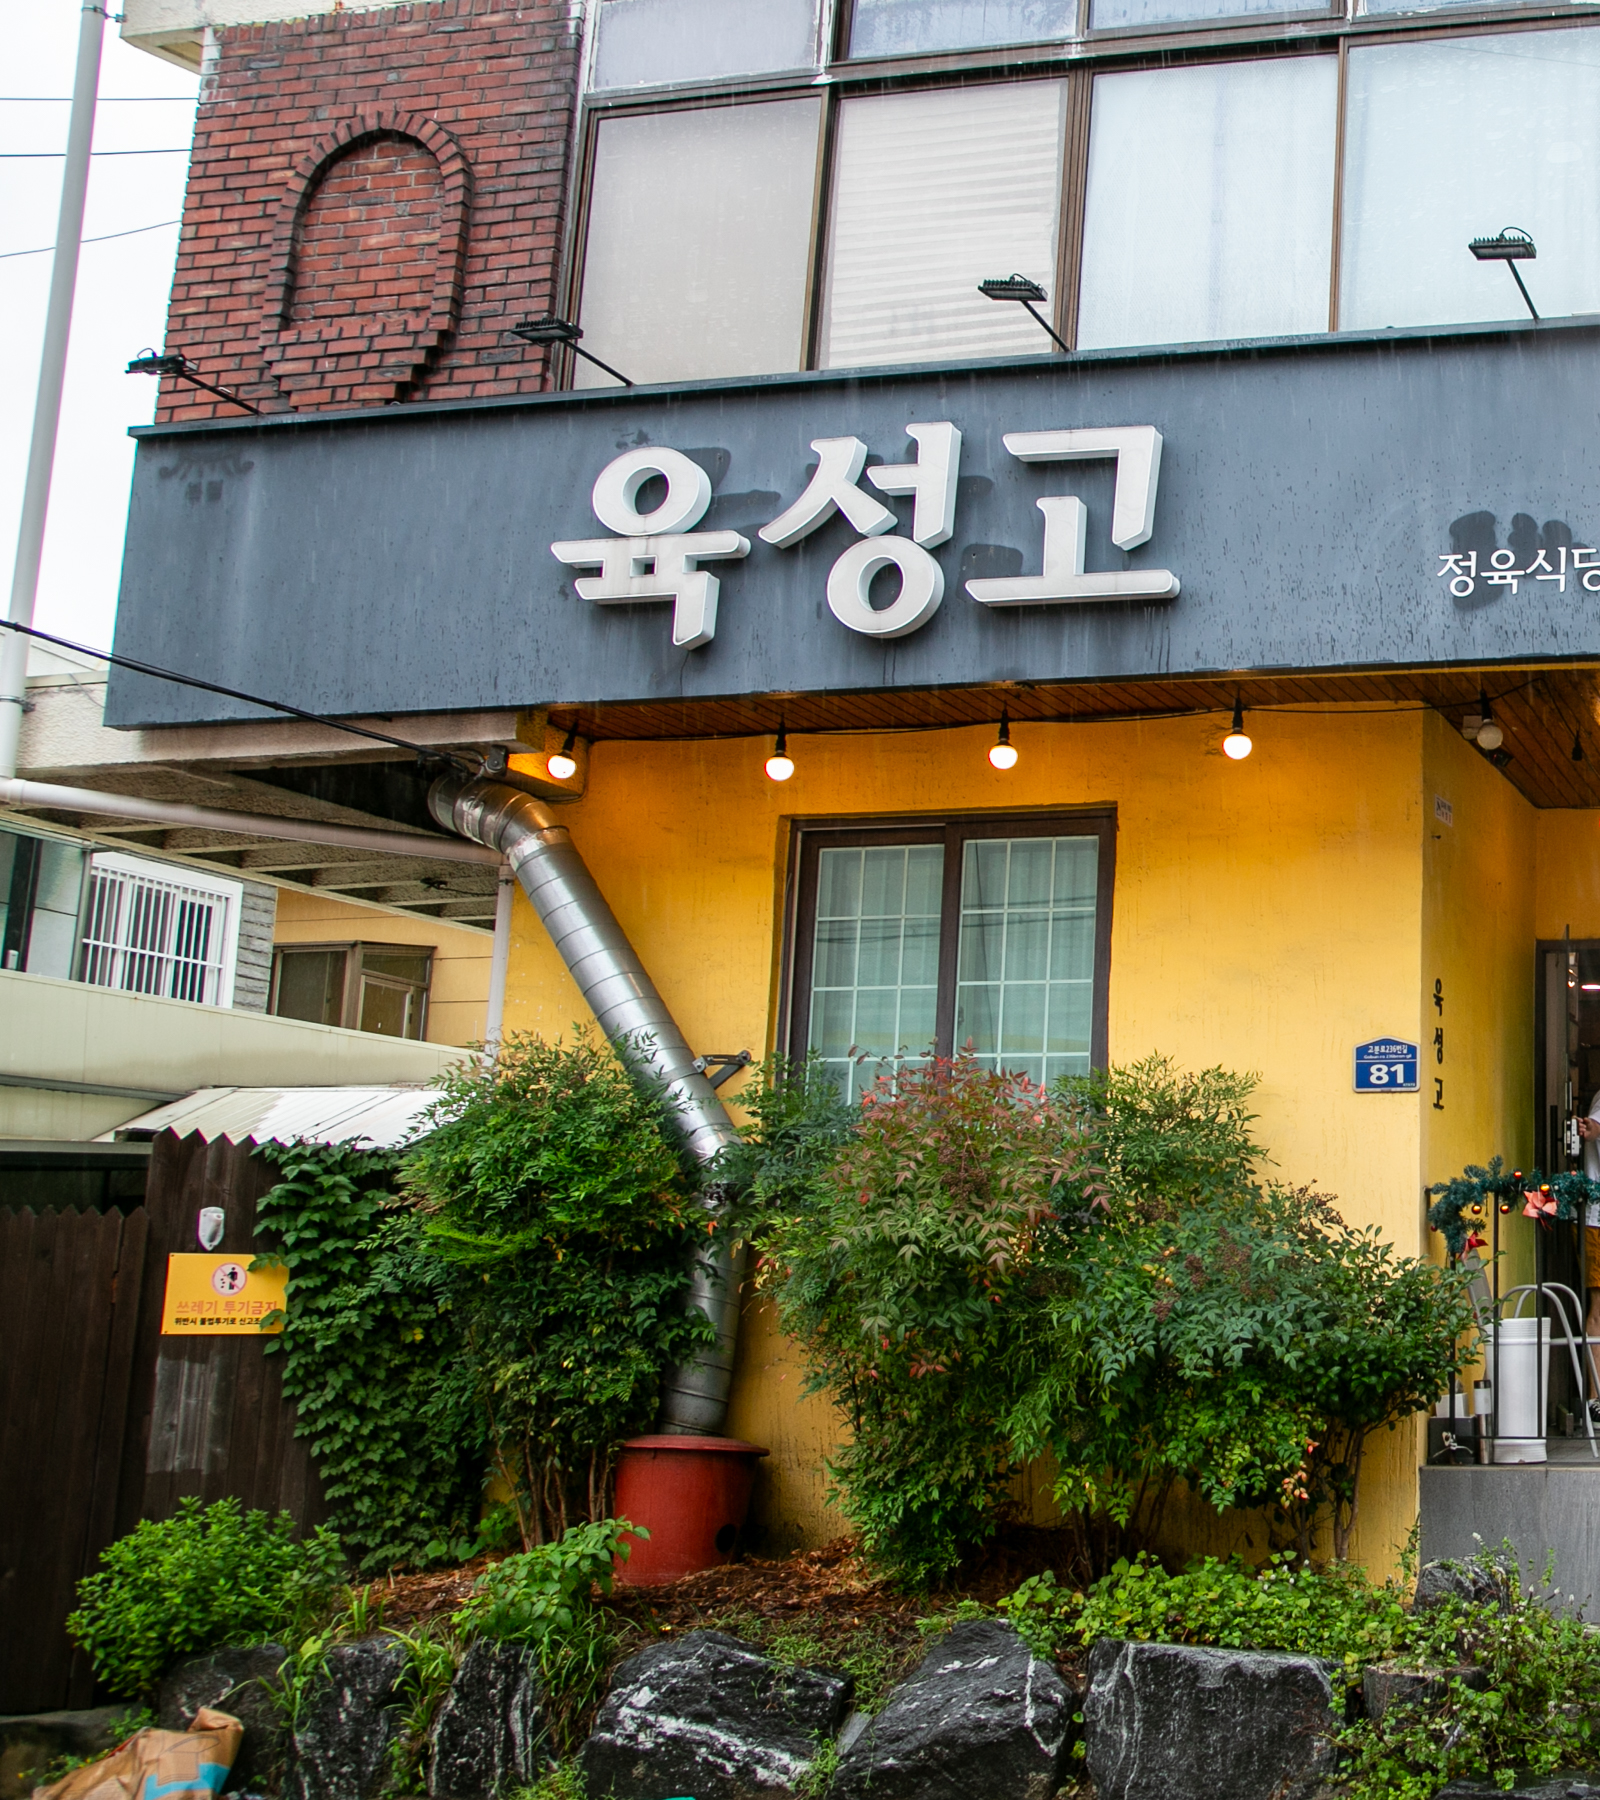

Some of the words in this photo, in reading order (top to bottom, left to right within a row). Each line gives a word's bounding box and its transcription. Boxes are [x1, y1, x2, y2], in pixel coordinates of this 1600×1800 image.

[551, 421, 1180, 650] 육성고
[1433, 978, 1444, 1111] 육성고
[1369, 1064, 1405, 1085] 81
[176, 1301, 218, 1315] 쓰레기
[223, 1301, 278, 1315] 투기금지
[175, 1317, 198, 1326] 위반시
[200, 1317, 237, 1326] 불법투기로
